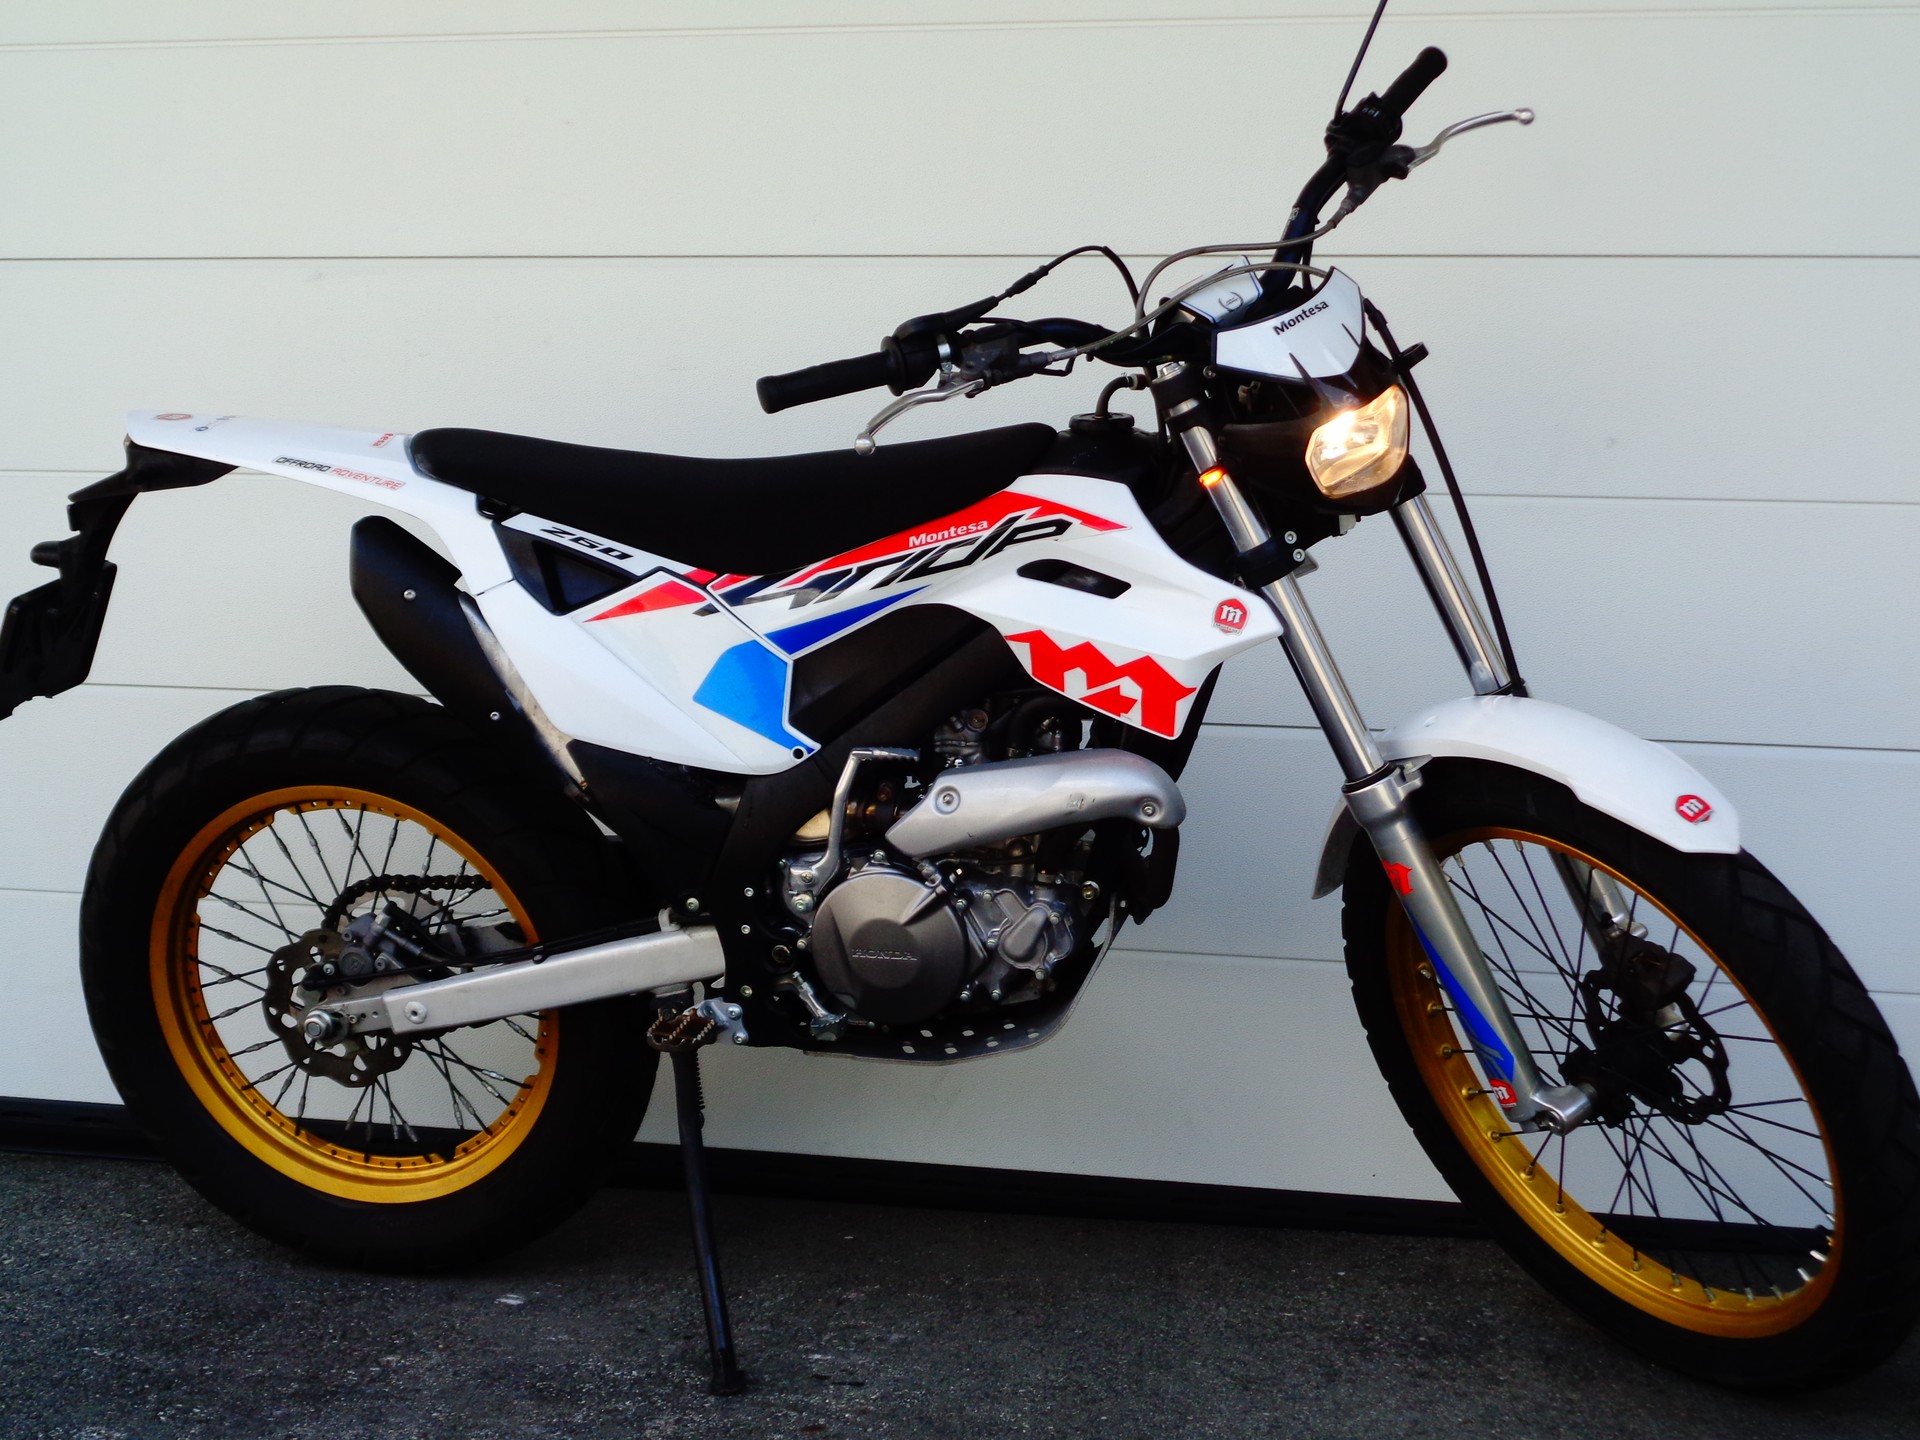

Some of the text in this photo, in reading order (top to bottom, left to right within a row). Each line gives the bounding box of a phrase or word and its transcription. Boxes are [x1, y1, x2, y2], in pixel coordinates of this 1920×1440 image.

[1272, 300, 1329, 336] Montesa
[275, 456, 402, 490] OFFROAD ADVENTURE
[908, 520, 989, 548] Montesa
[851, 948, 918, 961] HONDA
